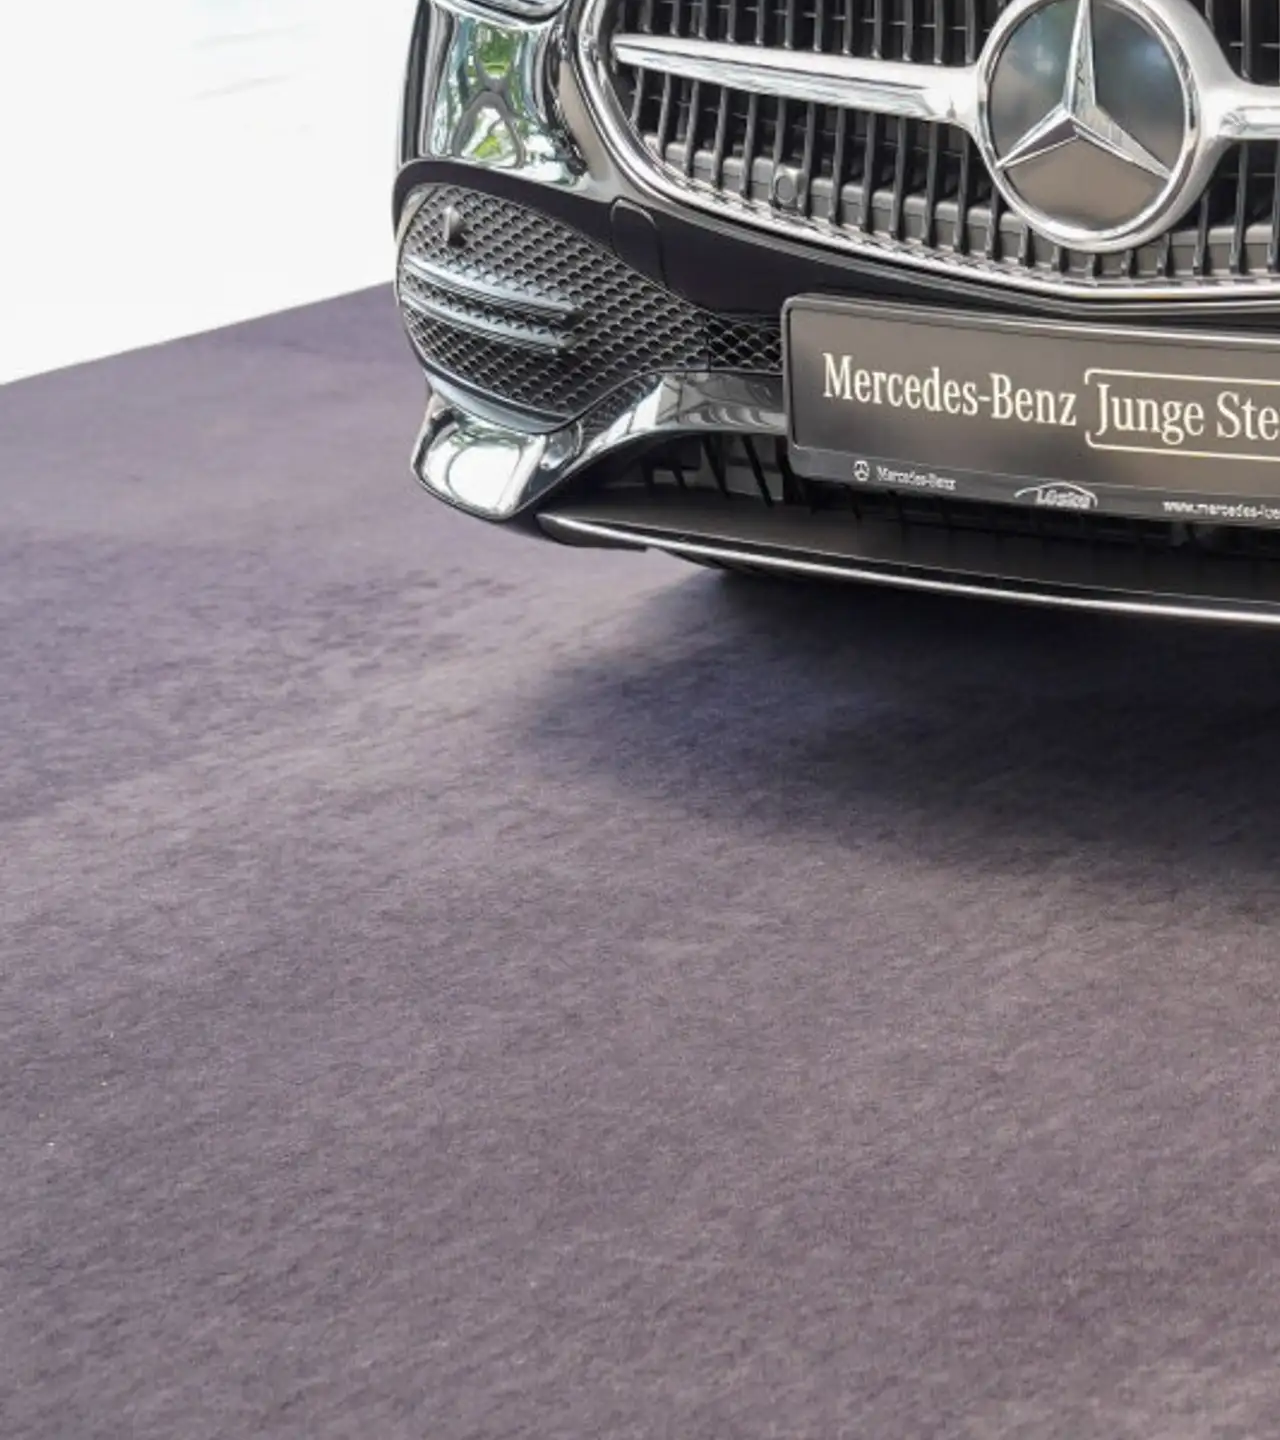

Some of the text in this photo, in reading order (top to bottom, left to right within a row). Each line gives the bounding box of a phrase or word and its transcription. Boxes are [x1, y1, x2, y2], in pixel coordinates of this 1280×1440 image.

[823, 352, 1077, 427] Mercedes-Benz
[1095, 383, 1205, 446] Junge
[876, 464, 956, 490] Mercedes-Benz
